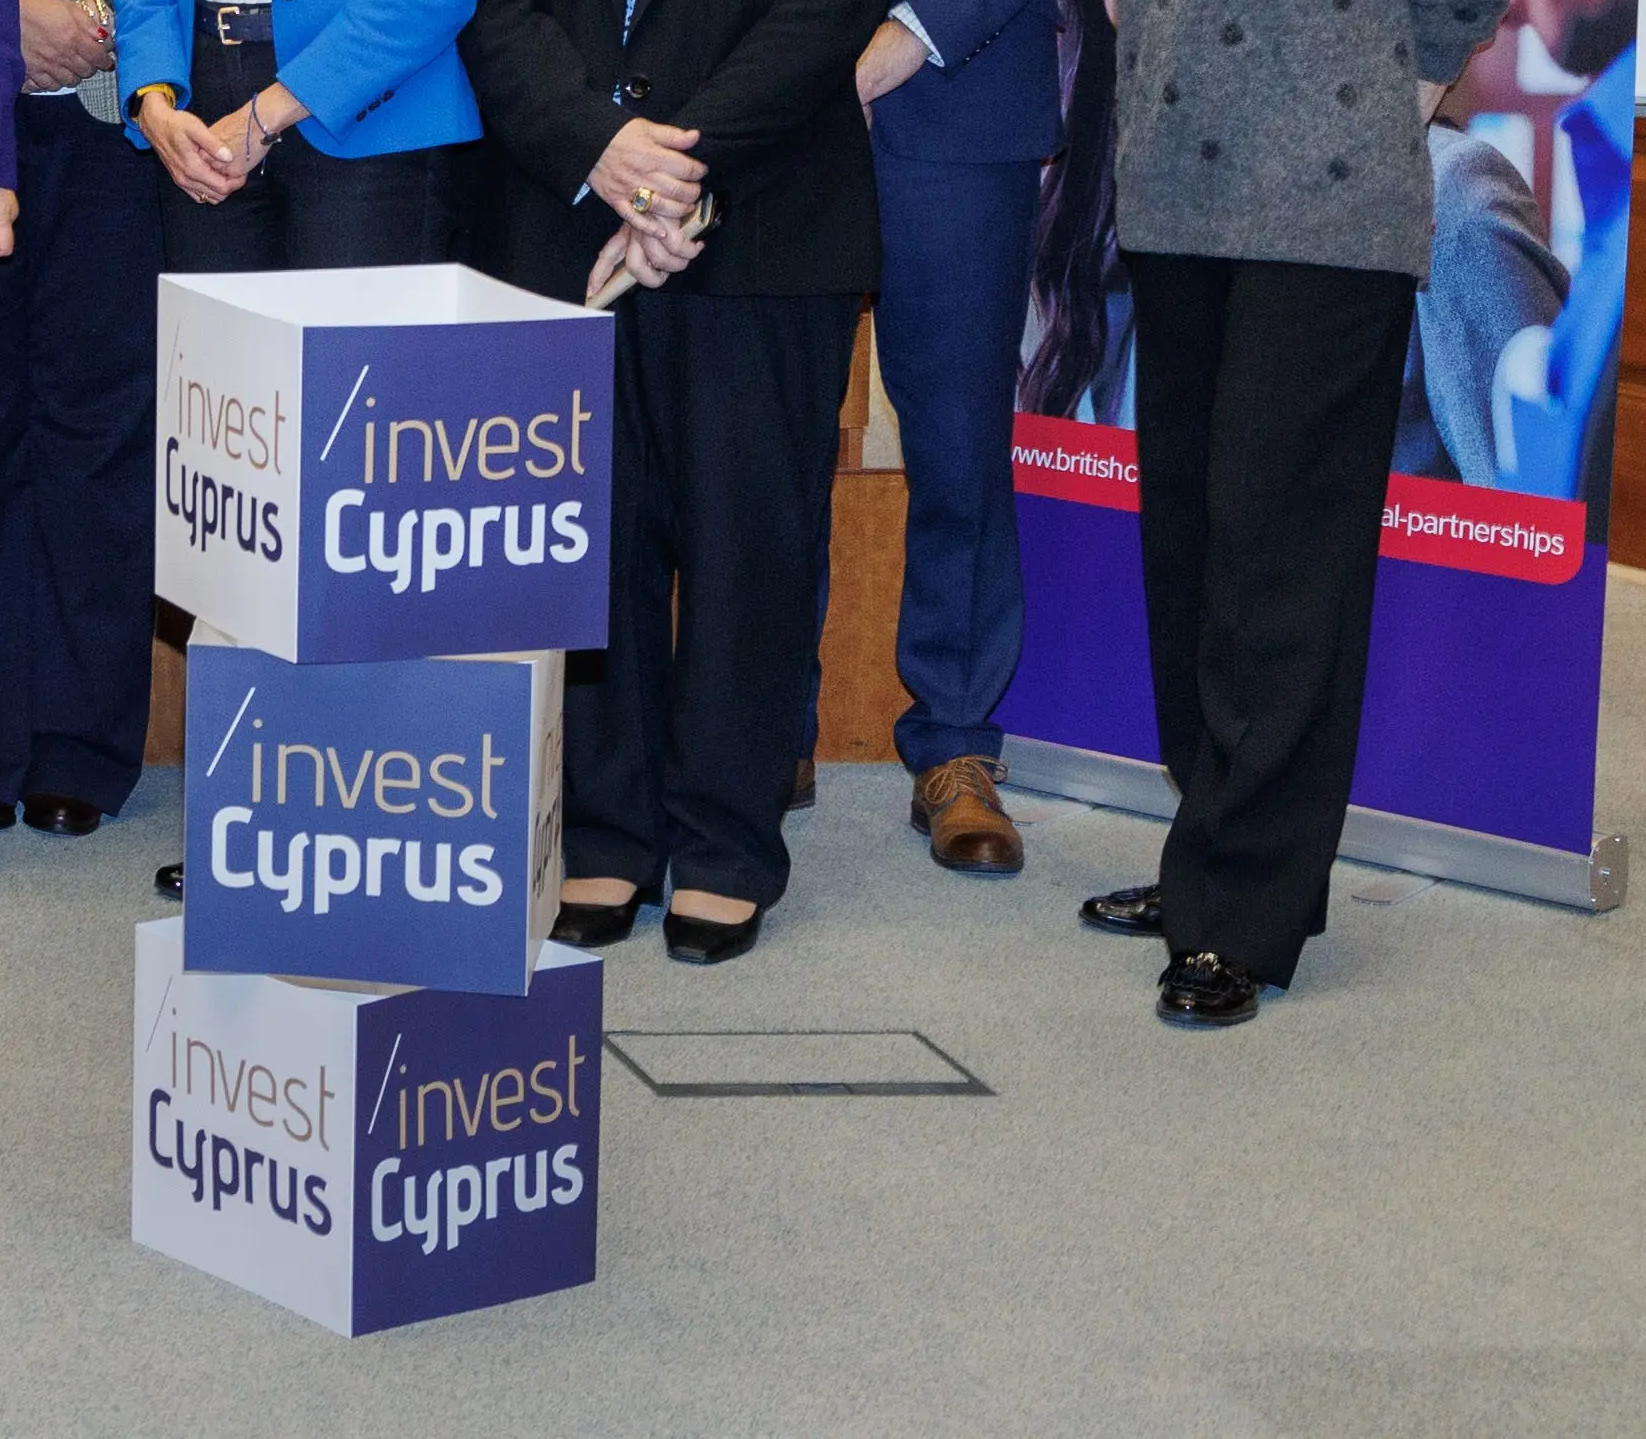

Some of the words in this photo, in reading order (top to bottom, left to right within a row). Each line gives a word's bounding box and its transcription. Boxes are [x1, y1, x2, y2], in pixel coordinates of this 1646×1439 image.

[165, 435, 283, 563] Cyprus
[323, 488, 590, 595] Cyprus
[1381, 504, 1565, 558] al-partnerships
[211, 805, 505, 915] Cyprus
[148, 1088, 333, 1237] Cyprus
[370, 1142, 585, 1256] Cyprus
